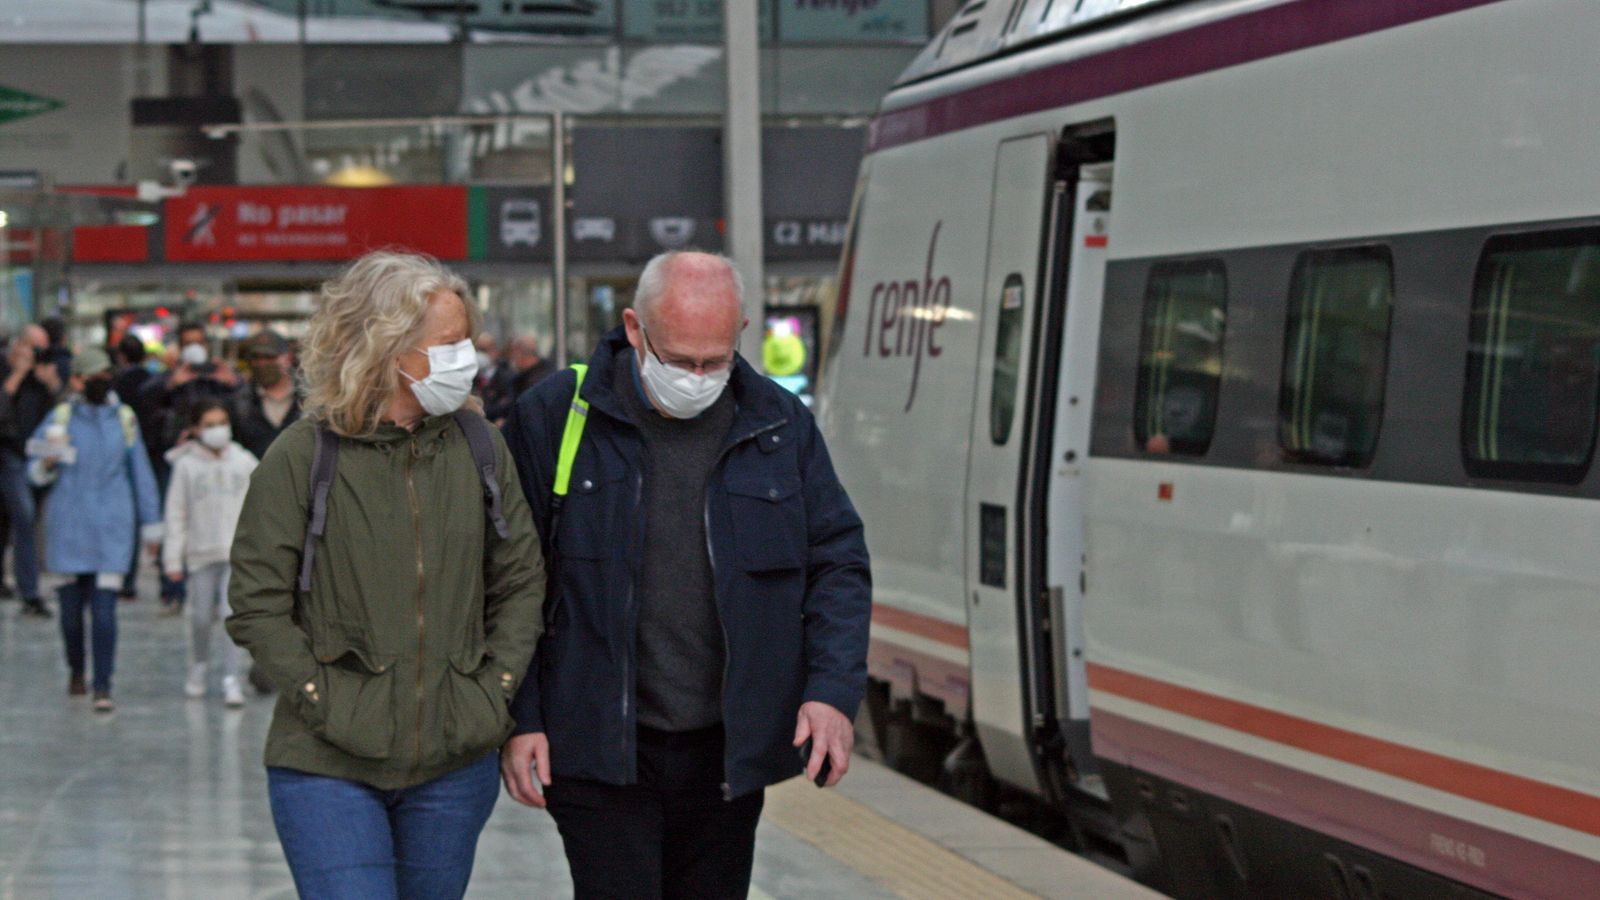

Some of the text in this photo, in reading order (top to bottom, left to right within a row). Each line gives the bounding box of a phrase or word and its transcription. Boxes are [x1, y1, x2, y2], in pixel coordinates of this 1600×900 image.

[237, 201, 347, 229] No pasar
[775, 221, 801, 244] C2
[863, 219, 952, 412] renfe
